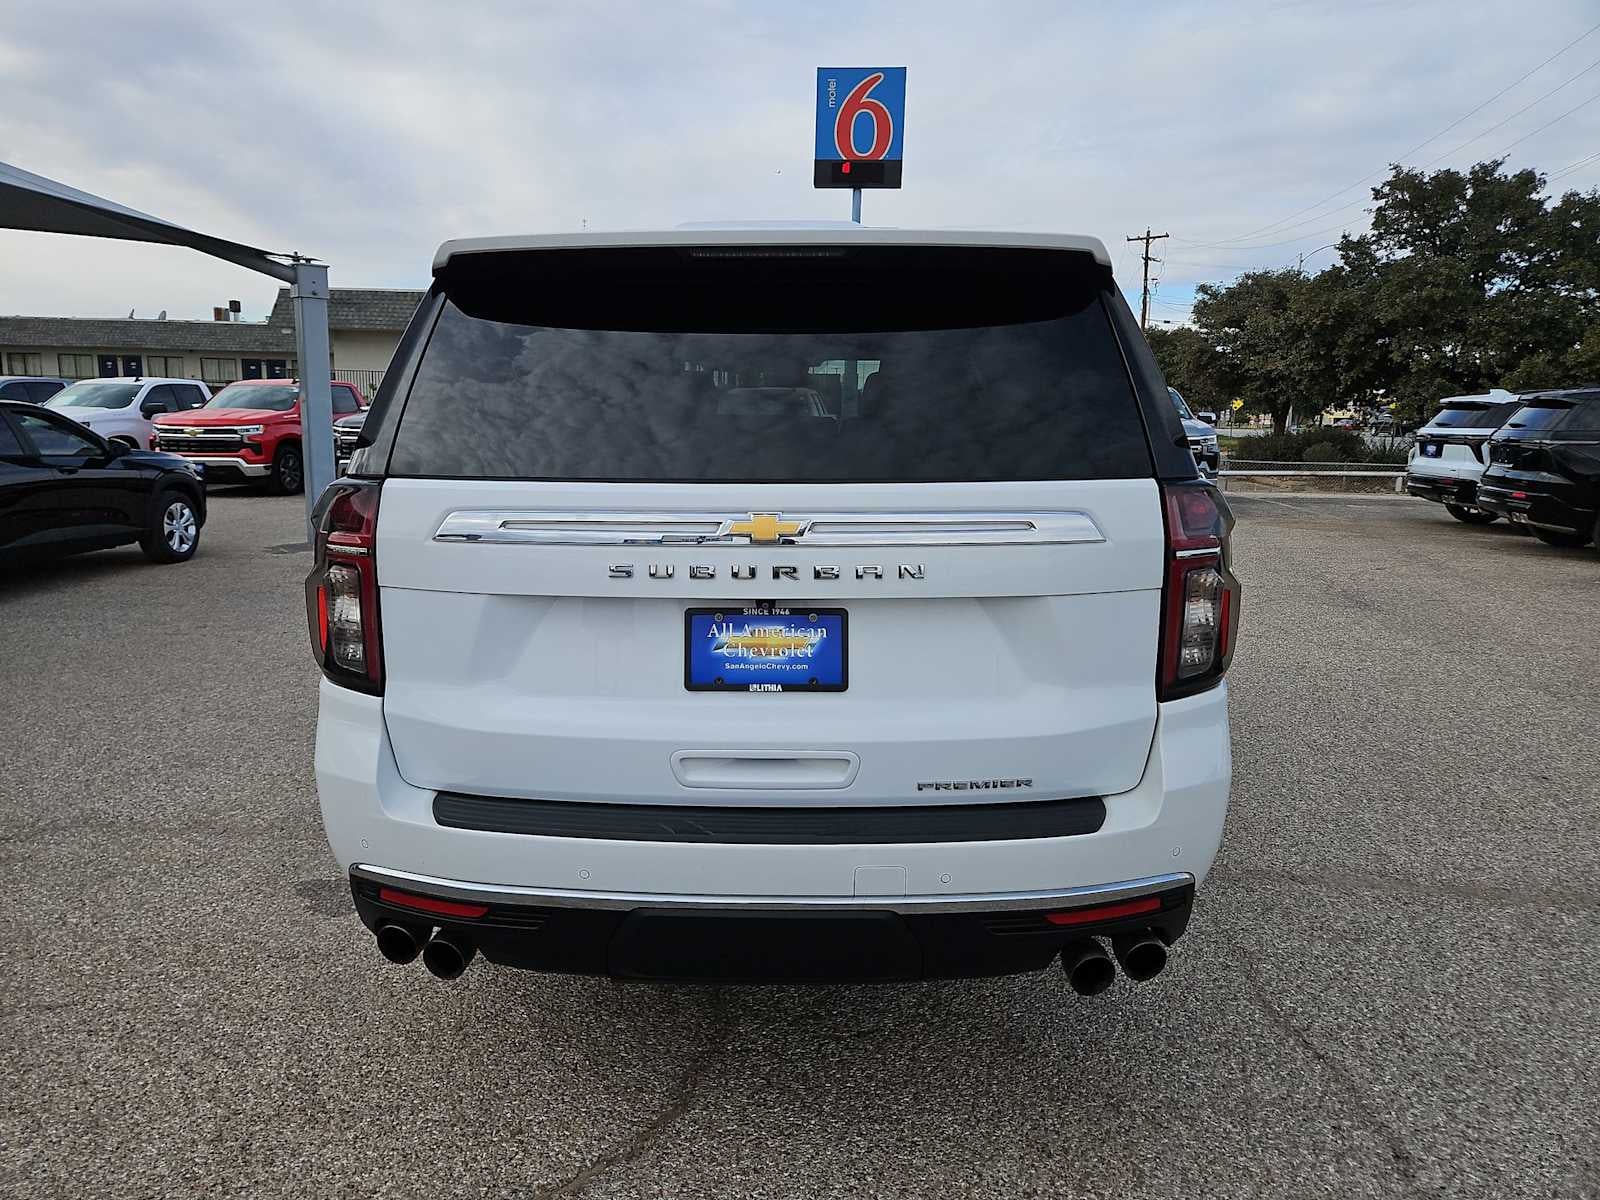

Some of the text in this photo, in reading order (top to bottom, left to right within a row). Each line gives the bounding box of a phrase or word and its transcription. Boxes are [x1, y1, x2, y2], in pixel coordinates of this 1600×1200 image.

[827, 79, 837, 108] motel
[834, 72, 894, 160] 6
[608, 563, 925, 581] SUBURBAN
[743, 607, 790, 616] SINCE 1946
[707, 623, 828, 639] All American
[723, 642, 814, 658] Chevrolet
[725, 662, 809, 671] SanAngeloChevy.com
[756, 683, 783, 692] LITHIA
[917, 779, 1033, 791] PREMIER
